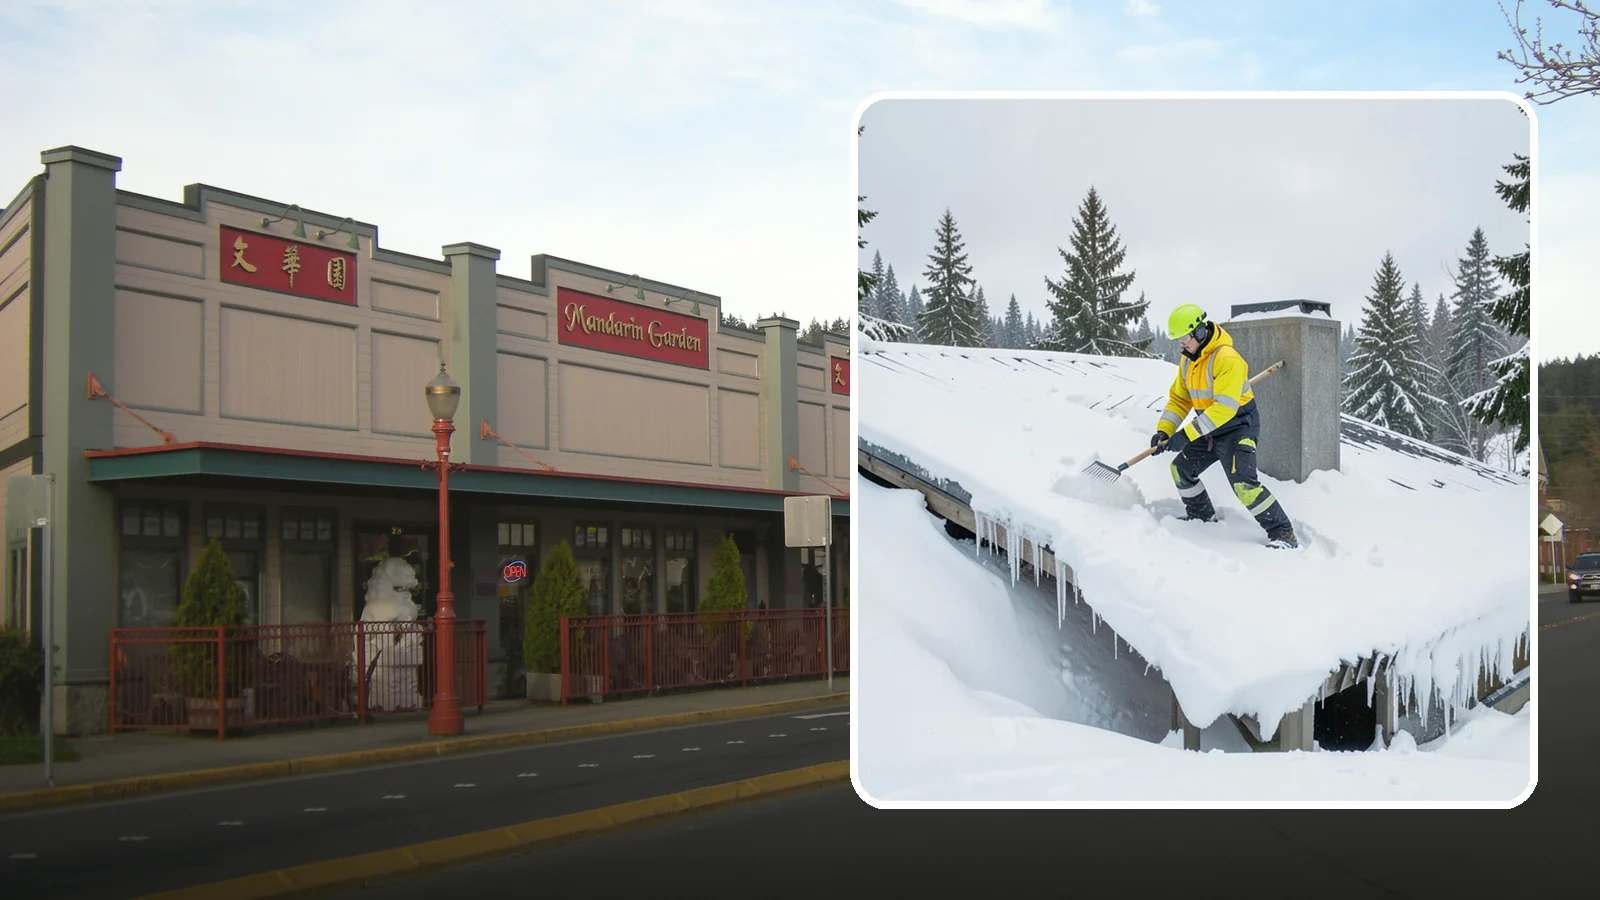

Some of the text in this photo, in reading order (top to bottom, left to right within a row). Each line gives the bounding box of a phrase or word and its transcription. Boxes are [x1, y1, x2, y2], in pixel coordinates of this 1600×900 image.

[231, 236, 346, 291] 文華園
[565, 302, 702, 352] Mandarin Garden
[503, 565, 527, 578] OPEN
